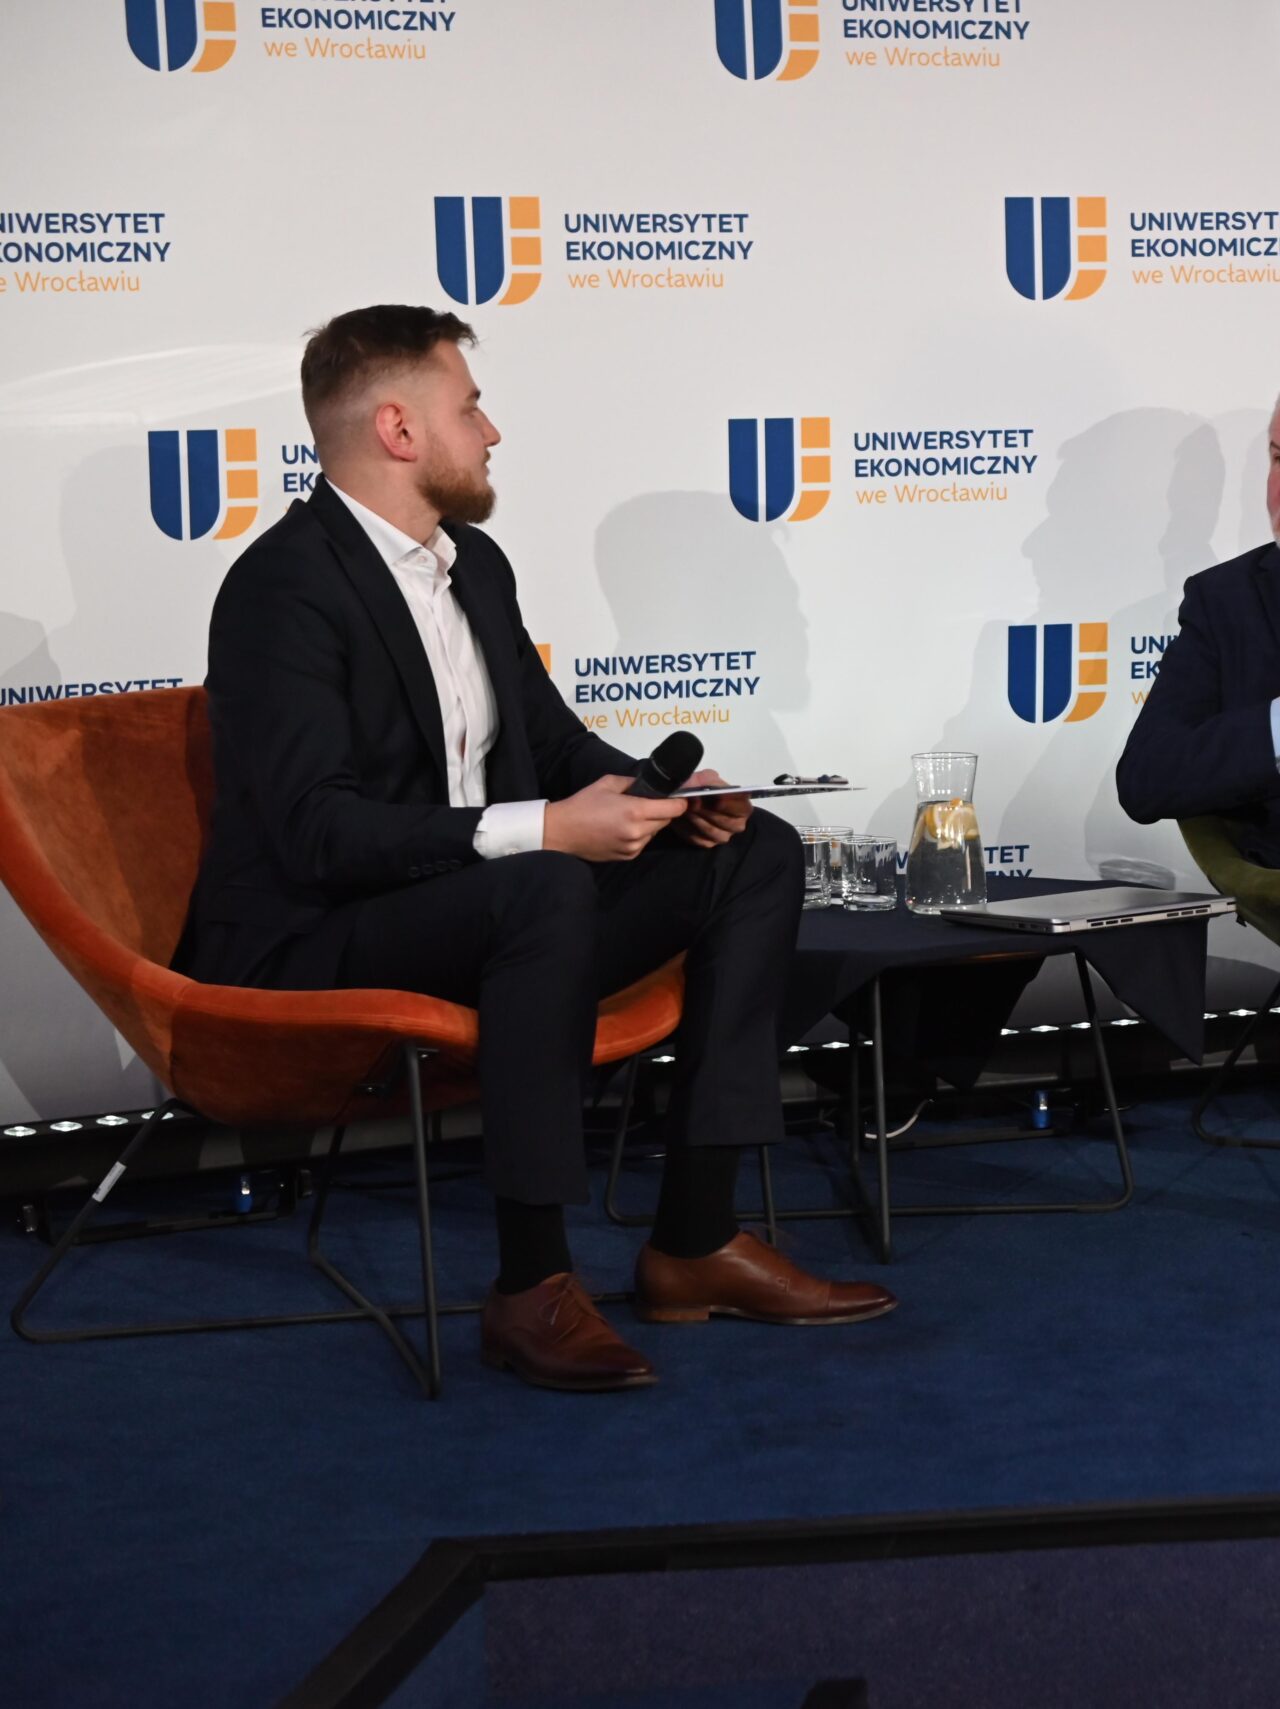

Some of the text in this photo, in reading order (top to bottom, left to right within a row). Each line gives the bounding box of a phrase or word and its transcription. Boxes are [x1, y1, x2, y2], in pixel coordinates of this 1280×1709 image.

[262, 8, 455, 31] EKONOMICZNY
[844, 19, 1029, 39] EKONOMICZNY
[263, 35, 426, 63] we Wrocławiu
[845, 47, 1002, 68] we Wrocławiu
[0, 213, 164, 233] IWERSYTET
[565, 214, 748, 233] UNIWERSYTET
[0, 242, 170, 262] ONOMICZNY
[567, 241, 753, 260] EKONOMICZNY
[13, 268, 141, 293] Wrocławiu
[568, 267, 725, 289] we Wrocławiu
[1132, 269, 1164, 284] we
[855, 430, 1033, 451] UNIWERSYTET
[855, 456, 1037, 477] EKONOMICZNY
[856, 484, 1008, 505] we Wrocławiu
[575, 651, 756, 676] UNIWERSYTET
[576, 677, 759, 703] EKONOMICZNY
[615, 705, 730, 728] Wrocławiu
